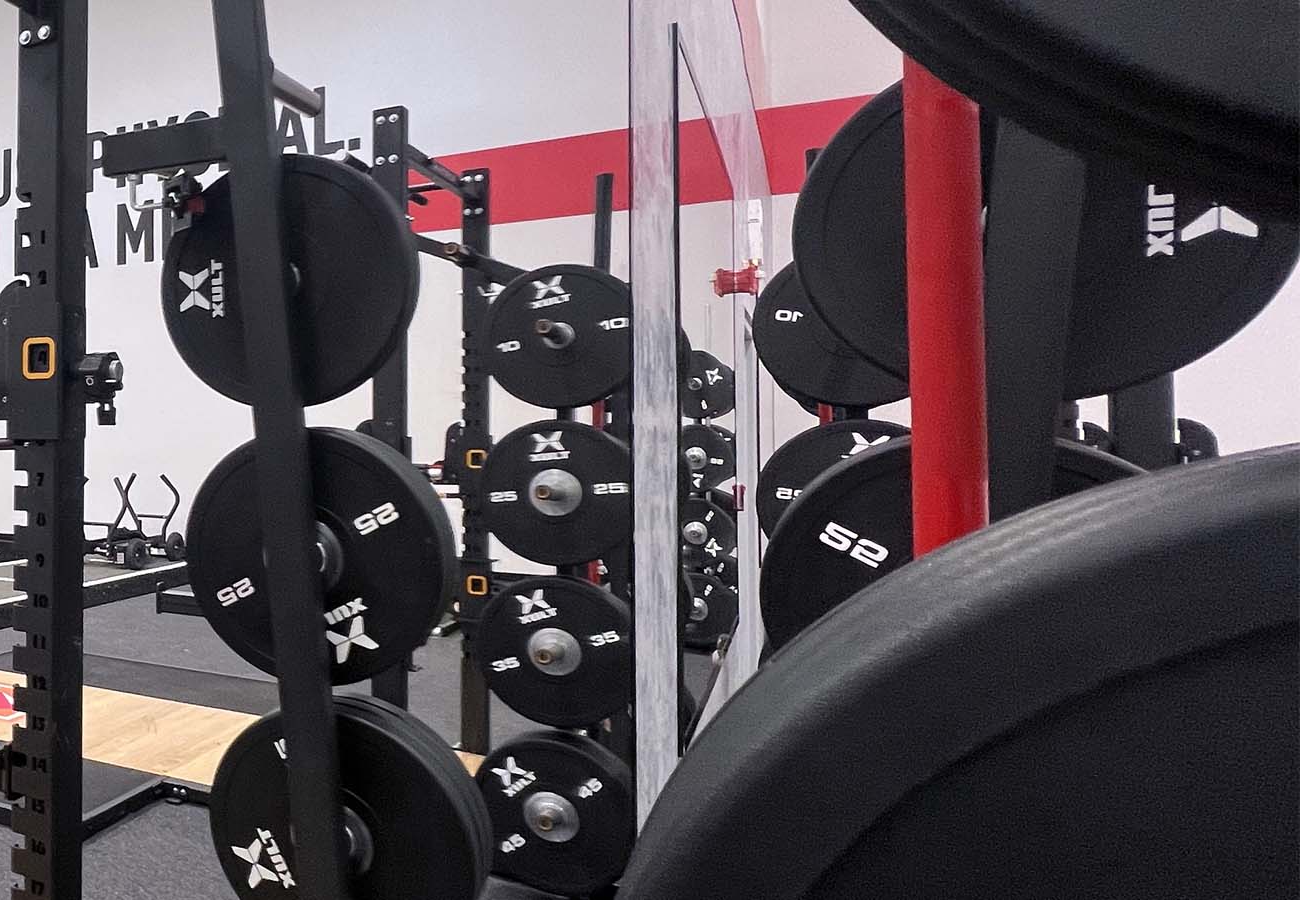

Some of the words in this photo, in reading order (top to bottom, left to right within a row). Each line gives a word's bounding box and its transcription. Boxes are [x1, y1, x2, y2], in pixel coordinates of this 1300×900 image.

[211, 259, 225, 319] XULT
[598, 317, 630, 331] 10
[592, 482, 629, 495] 25
[489, 490, 518, 503] 25
[589, 630, 621, 647] 35
[256, 827, 296, 889] XULT
